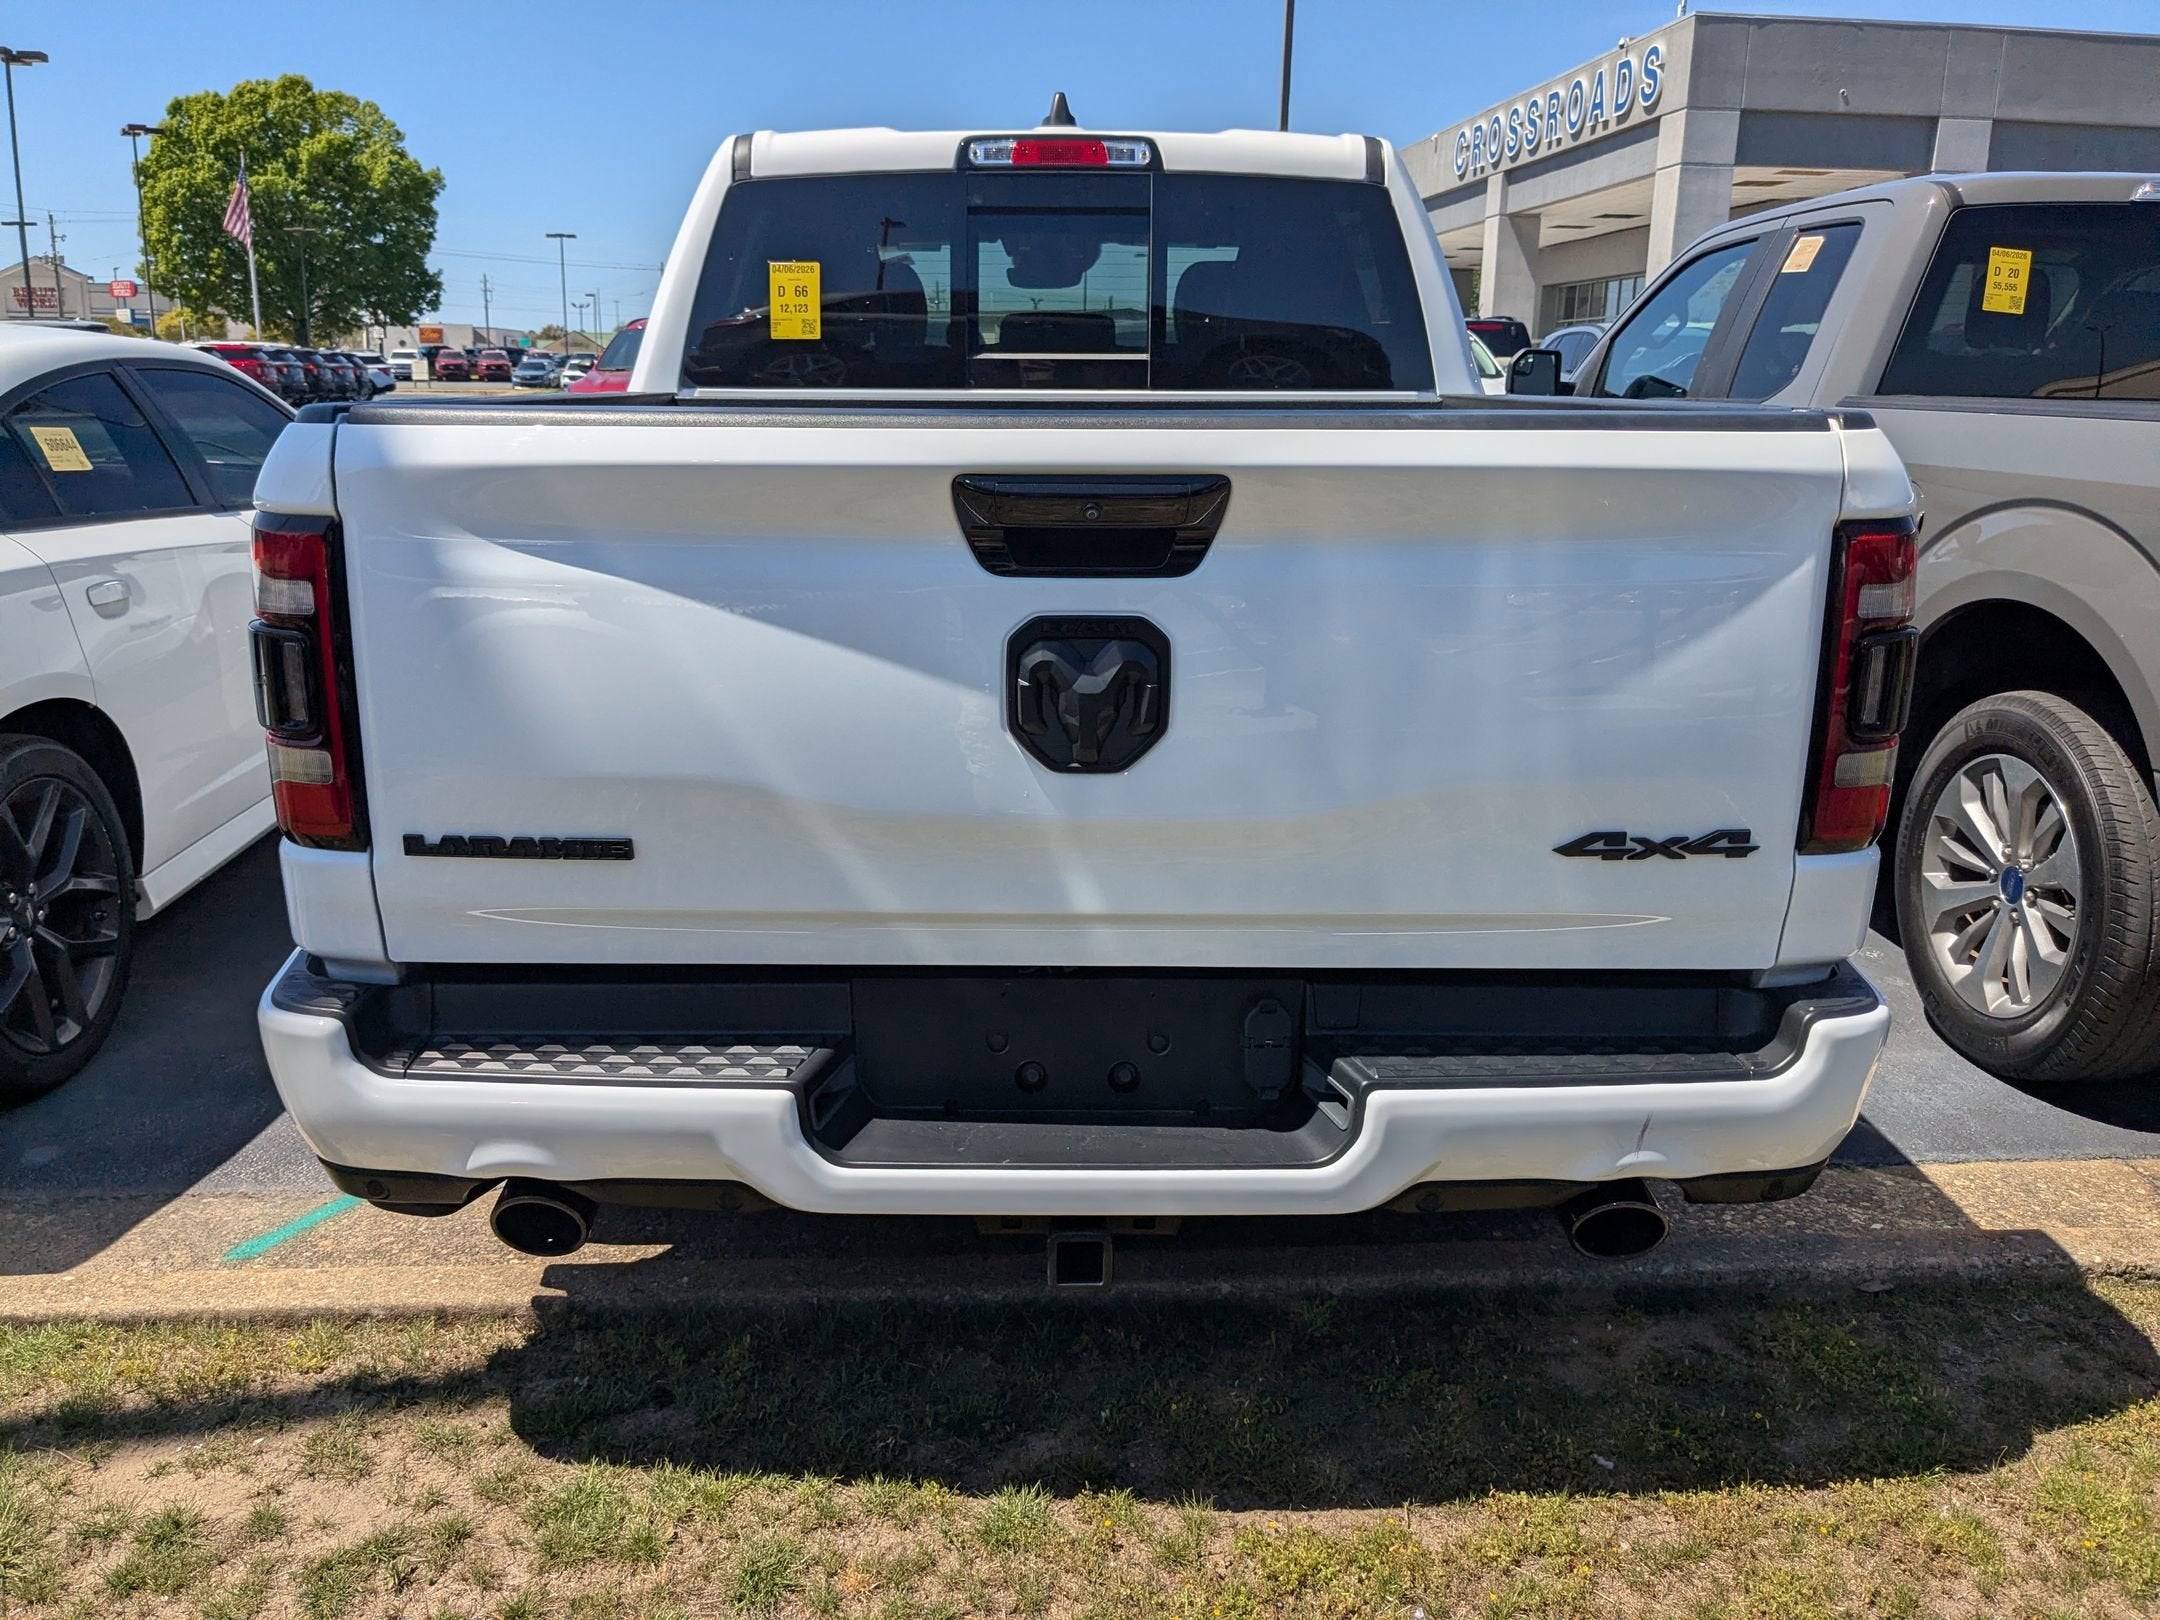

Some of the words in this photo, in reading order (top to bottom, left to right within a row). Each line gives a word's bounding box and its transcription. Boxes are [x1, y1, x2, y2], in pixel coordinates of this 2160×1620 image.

[1453, 43, 1664, 176] CROSSROADS
[1995, 267, 2001, 276] D
[2008, 268, 2019, 278] 20
[778, 286, 785, 297] D
[795, 285, 808, 297] 66
[780, 304, 808, 313] 12,123
